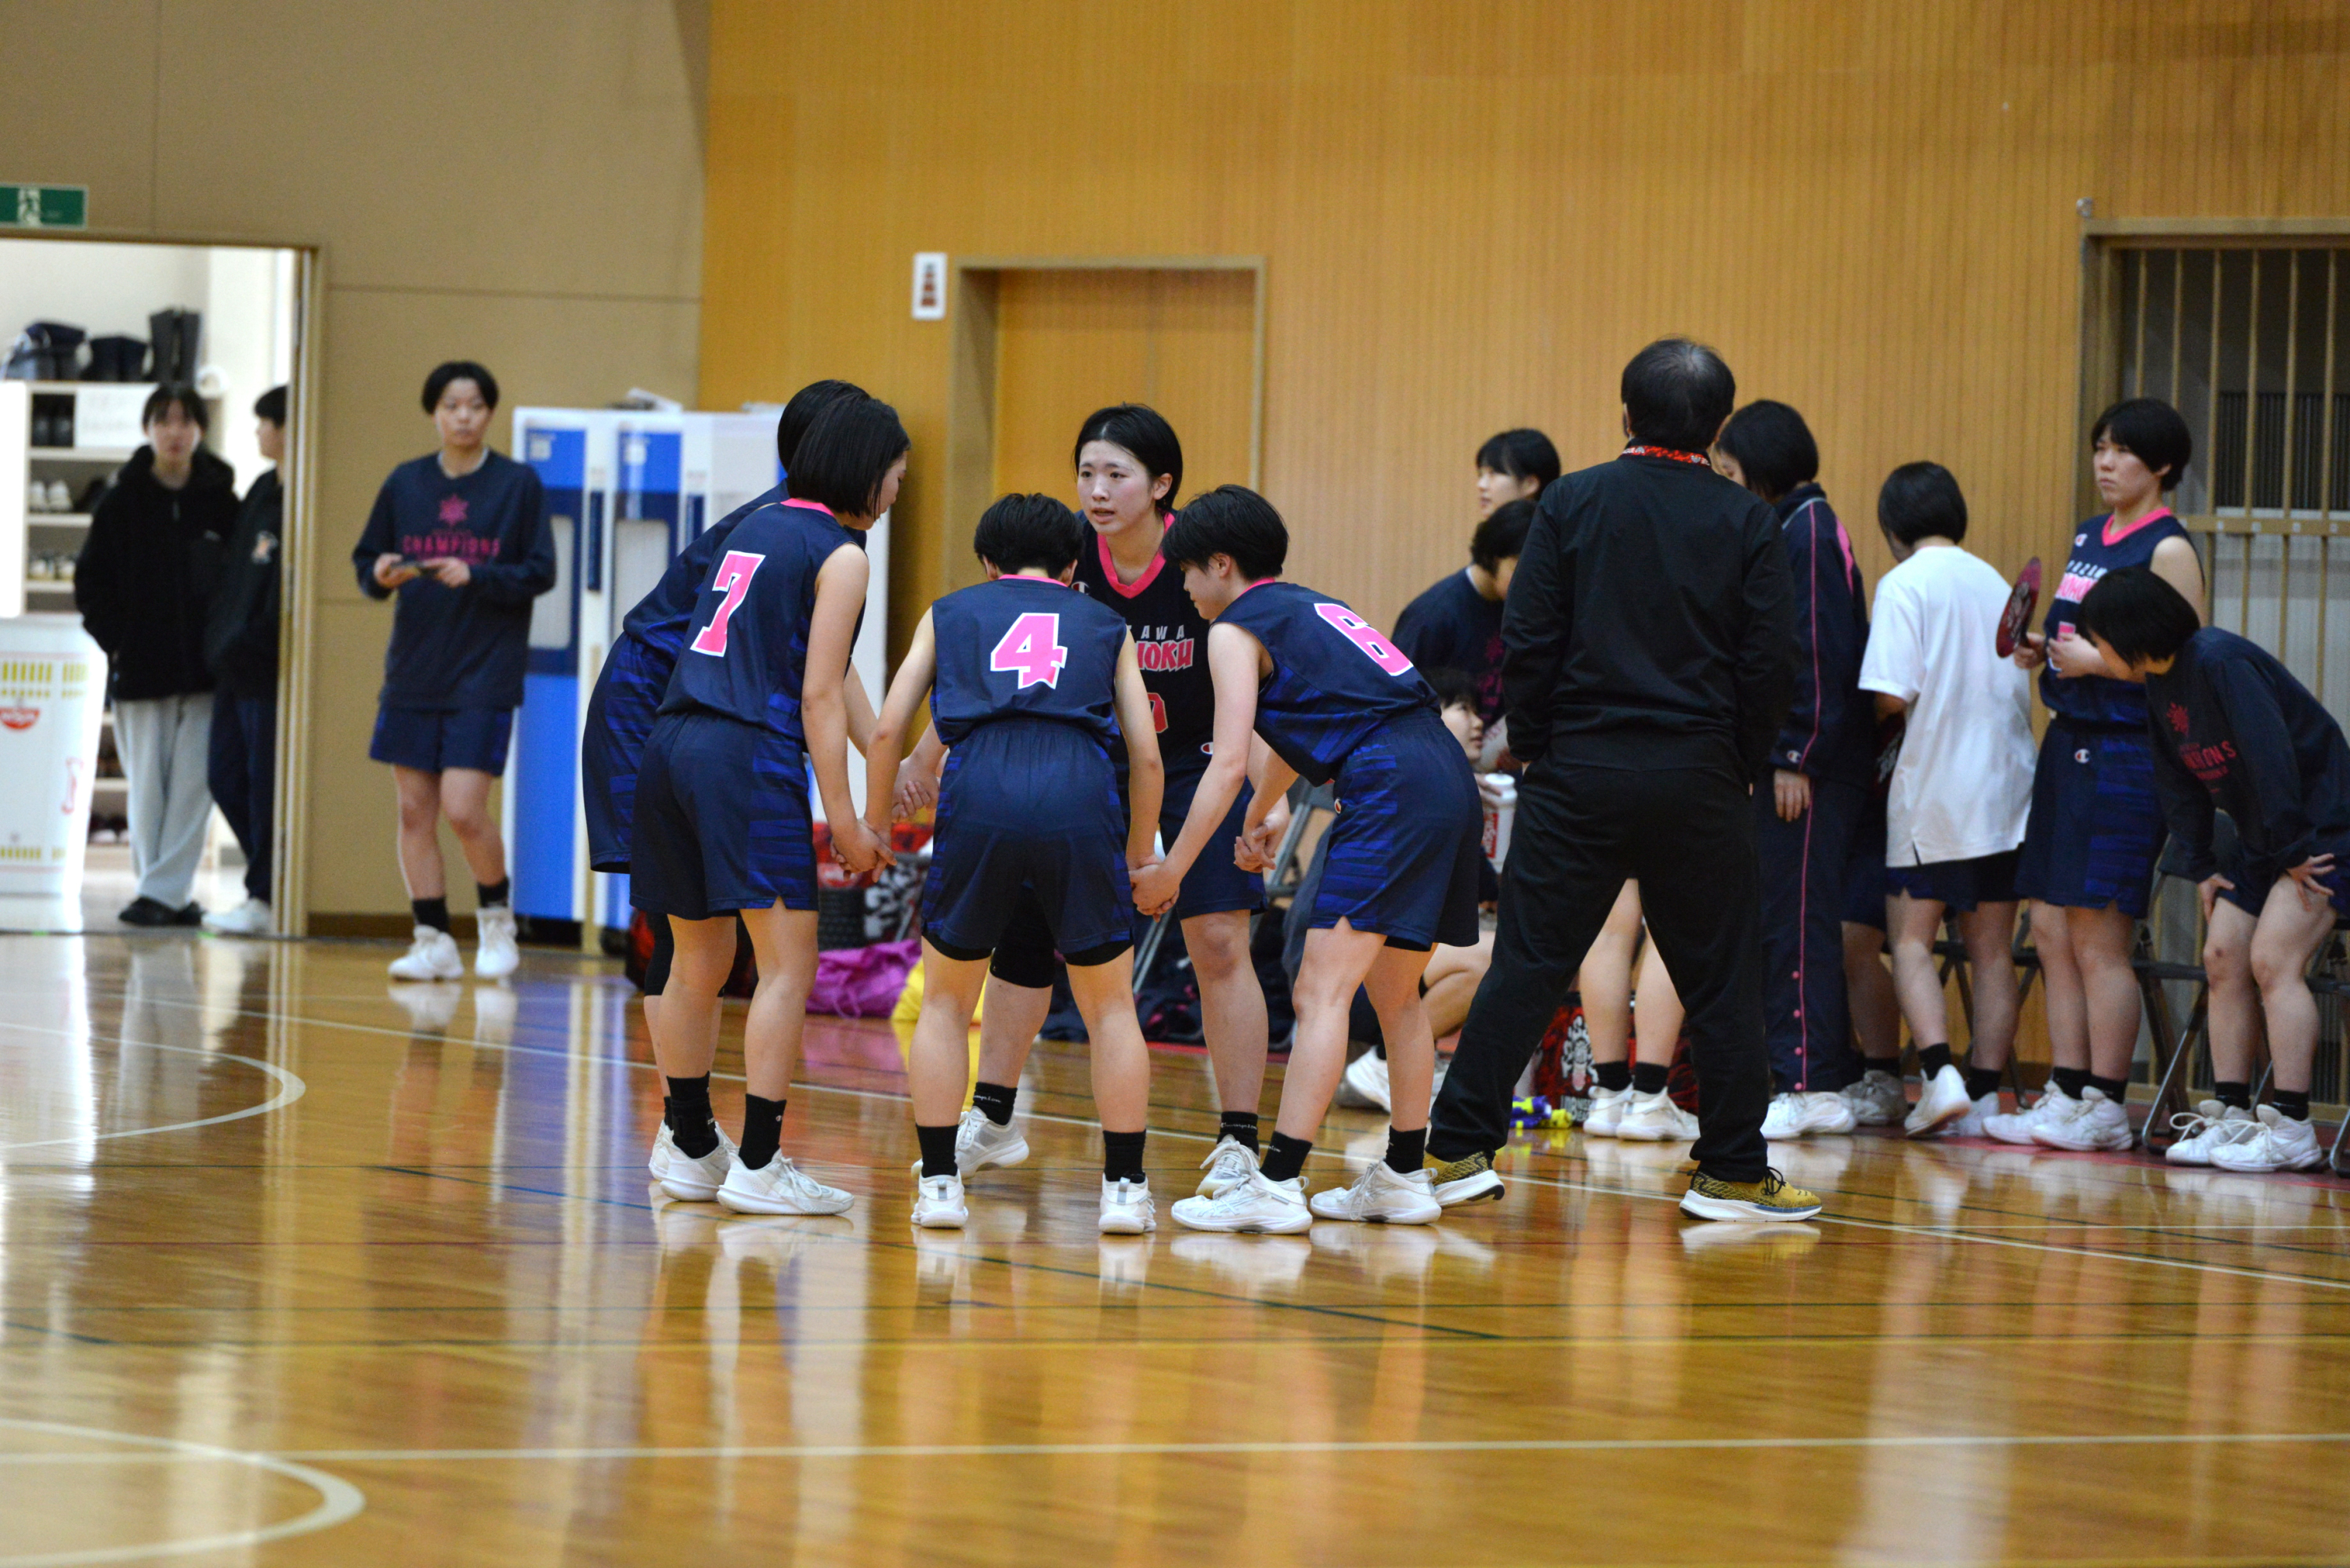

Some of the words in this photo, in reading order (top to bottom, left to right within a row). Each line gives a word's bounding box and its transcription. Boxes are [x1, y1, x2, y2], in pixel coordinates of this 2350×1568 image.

[689, 550, 766, 657] 7
[1128, 625, 1184, 641] AWA
[1314, 603, 1414, 677] 6
[990, 612, 1068, 689] 4
